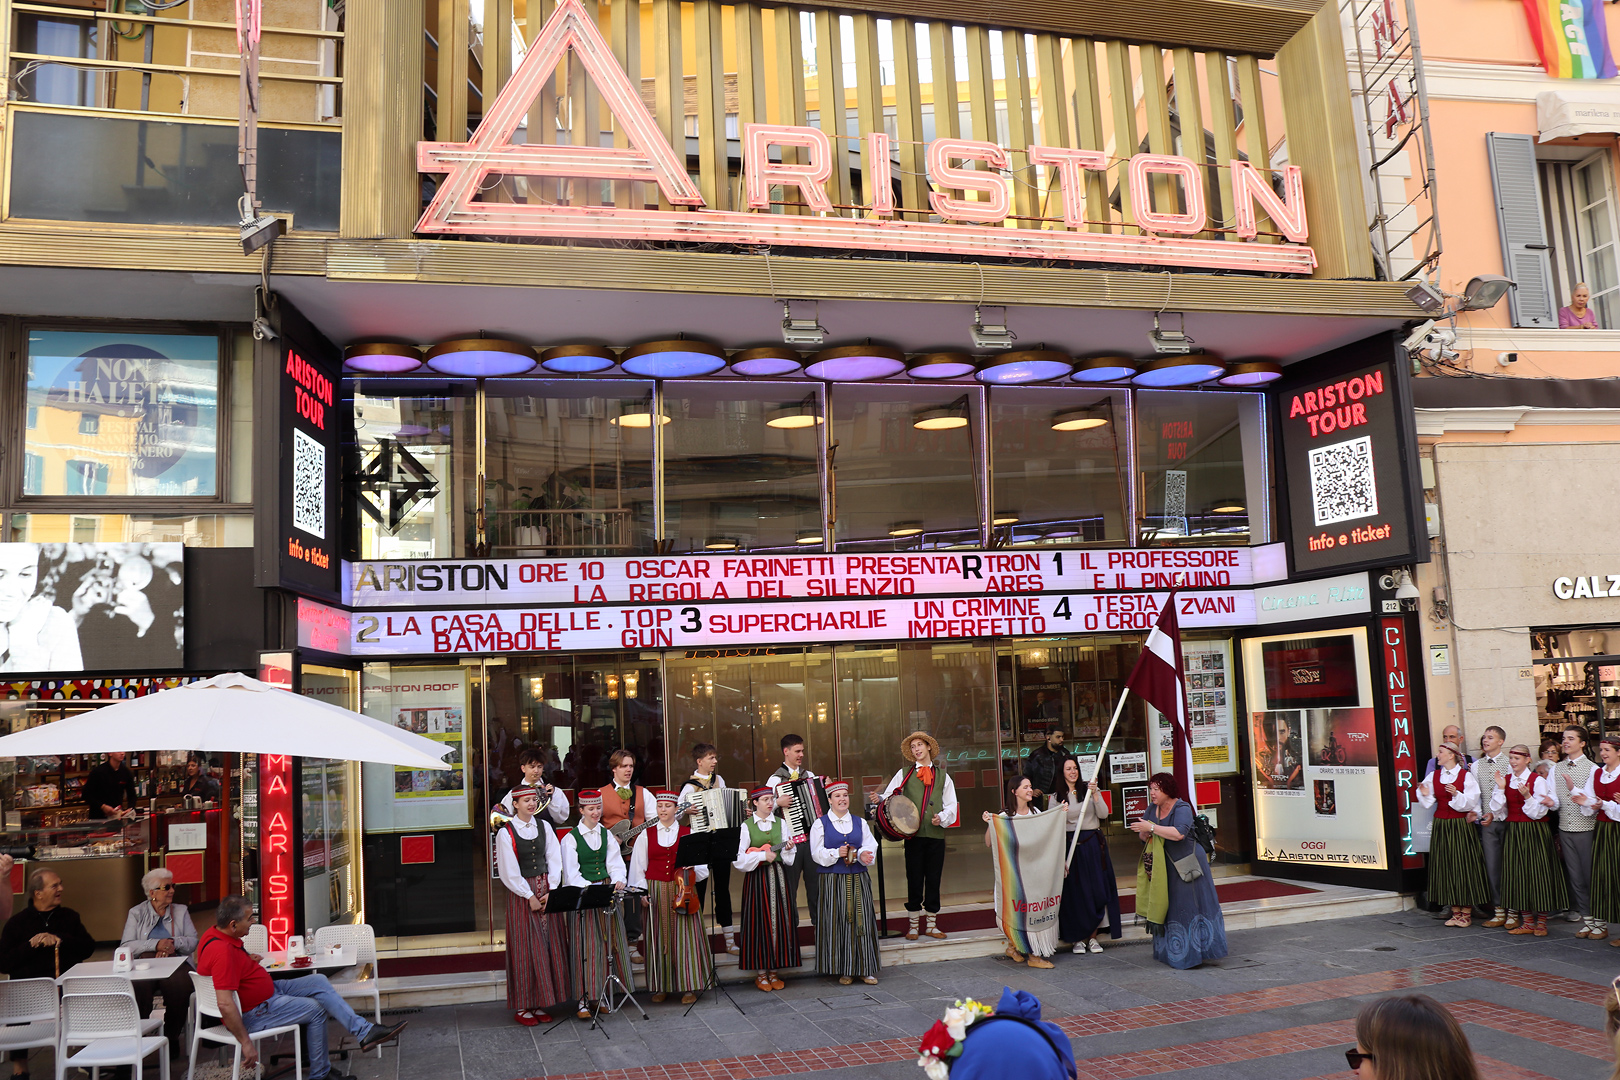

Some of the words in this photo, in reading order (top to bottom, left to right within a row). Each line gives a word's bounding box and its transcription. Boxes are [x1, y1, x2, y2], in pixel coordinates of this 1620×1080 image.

[415, 0, 1317, 276] ARISTON
[95, 358, 150, 381] NON
[286, 349, 333, 407] ARISTON
[1289, 370, 1384, 419] ARISTON
[295, 386, 325, 430] TOUR
[1307, 402, 1368, 437] TOUR
[86, 421, 97, 432] IL
[139, 446, 173, 458] NERO
[1309, 533, 1335, 551] info
[1338, 534, 1348, 546] e
[1351, 524, 1391, 544] ticket
[288, 538, 303, 559] info
[304, 552, 310, 562] e
[311, 551, 329, 570] ticket
[962, 555, 983, 579] R
[984, 553, 1040, 573] TRON
[1052, 552, 1063, 576] 1
[1080, 552, 1098, 570] IL
[1108, 550, 1239, 569] PROFESSORE
[356, 564, 508, 591] ARISTON
[518, 563, 568, 583] ORE
[579, 561, 604, 580] 10
[625, 559, 710, 579] OSCAR
[723, 557, 835, 578] FARINETTI
[846, 556, 961, 575] PRESENTA
[985, 574, 1043, 593] ARES
[1094, 574, 1105, 590] E
[1116, 573, 1133, 590] IL
[573, 585, 608, 604] LA
[629, 581, 729, 602] REGOLA
[746, 580, 792, 599] DEL
[806, 577, 915, 597] SILENZIO
[1261, 592, 1319, 611] Cinema
[1328, 586, 1365, 604] Ritz
[1554, 575, 1620, 600] CALZ
[914, 601, 944, 619] UN
[952, 598, 1040, 617] CRIMINE
[1052, 597, 1072, 620] 4
[1093, 594, 1158, 613] TESTA
[1180, 596, 1235, 615] ZVANI
[1385, 602, 1397, 611] 212
[356, 616, 380, 643] 2
[386, 616, 422, 636] LA
[431, 613, 503, 634] CASA
[621, 609, 672, 628] TOP
[680, 607, 702, 633] 3
[709, 609, 887, 633] SUPERCHARLIE
[908, 616, 1046, 638] IMPERFETTO
[1084, 613, 1098, 630] O
[1106, 612, 1160, 629] CROC
[433, 631, 562, 652] BAMBOLE
[621, 628, 672, 648] GUN
[362, 684, 421, 693] ARISTON
[423, 683, 459, 691] ROOF
[1385, 627, 1411, 758] CINEMA
[1277, 849, 1324, 861] ARISTON
[1352, 854, 1377, 865] CINEMA
[1301, 841, 1326, 850] OGGI
[268, 812, 289, 953] ARISTON
